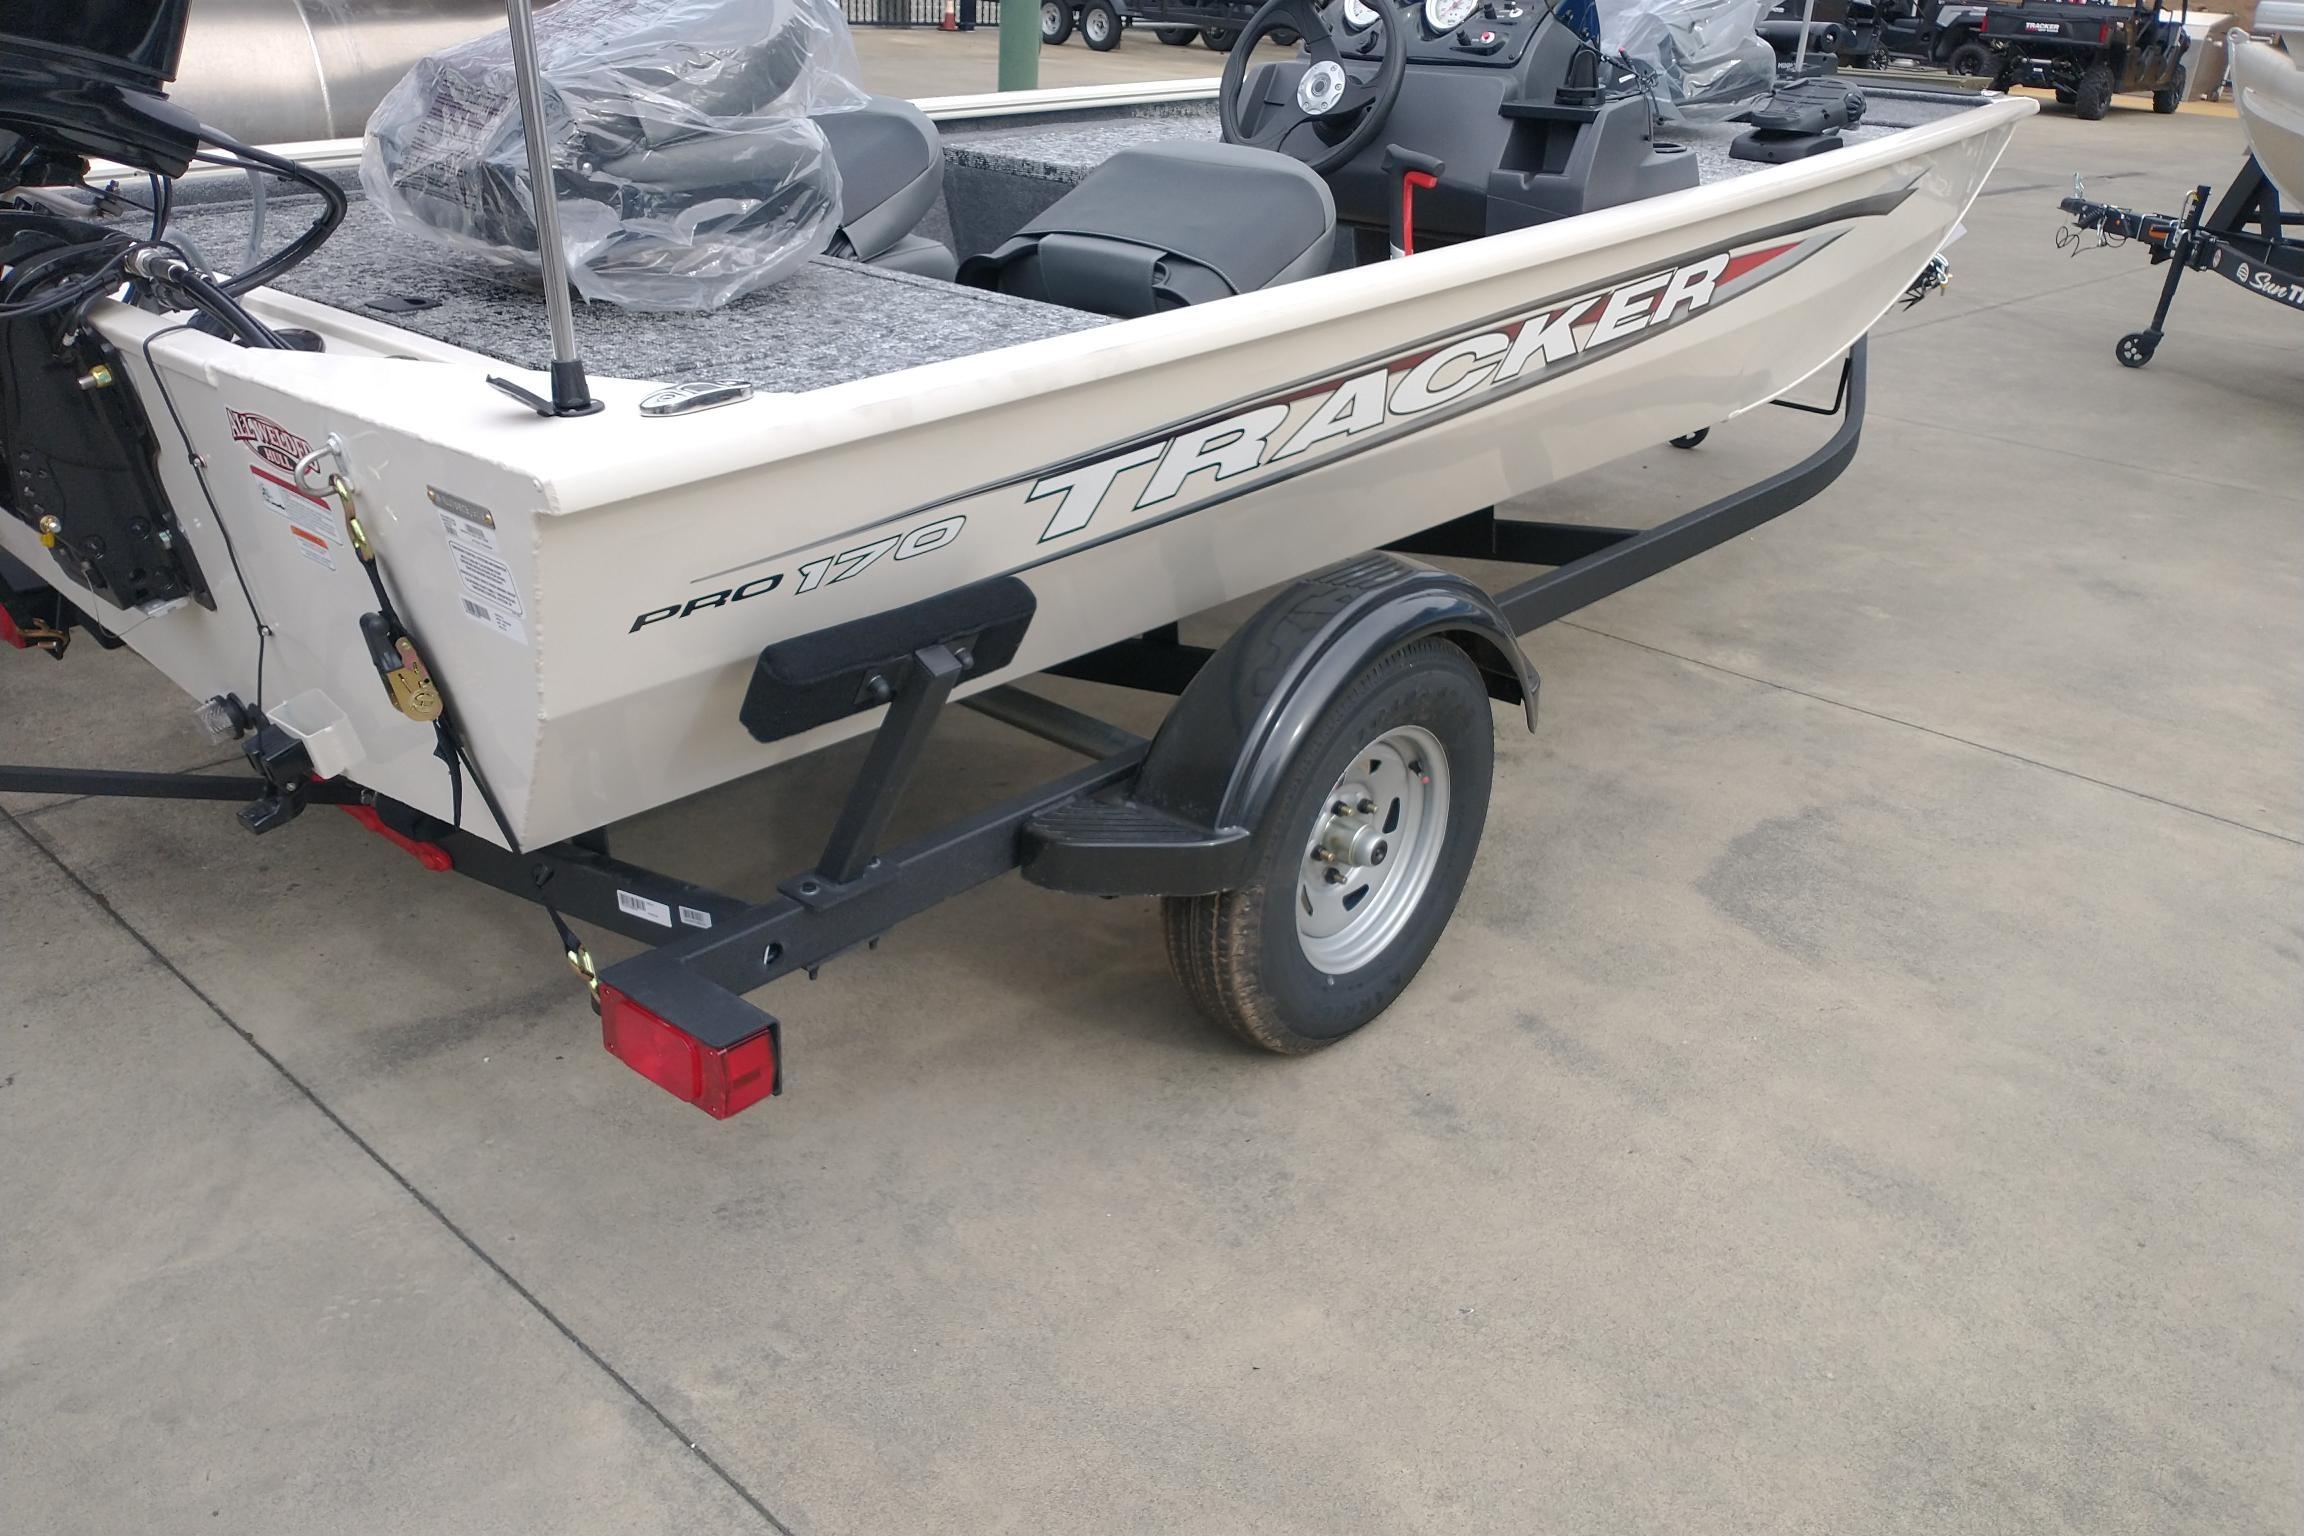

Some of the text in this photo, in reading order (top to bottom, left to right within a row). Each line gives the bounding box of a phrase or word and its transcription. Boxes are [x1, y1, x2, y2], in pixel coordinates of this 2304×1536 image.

[2026, 22, 2060, 30] TRACKER
[2249, 272, 2288, 298] Sun
[1026, 252, 1731, 545] TRACKER
[226, 407, 257, 440] ALL
[263, 446, 292, 469] HULL
[628, 515, 967, 634] PRO 170
